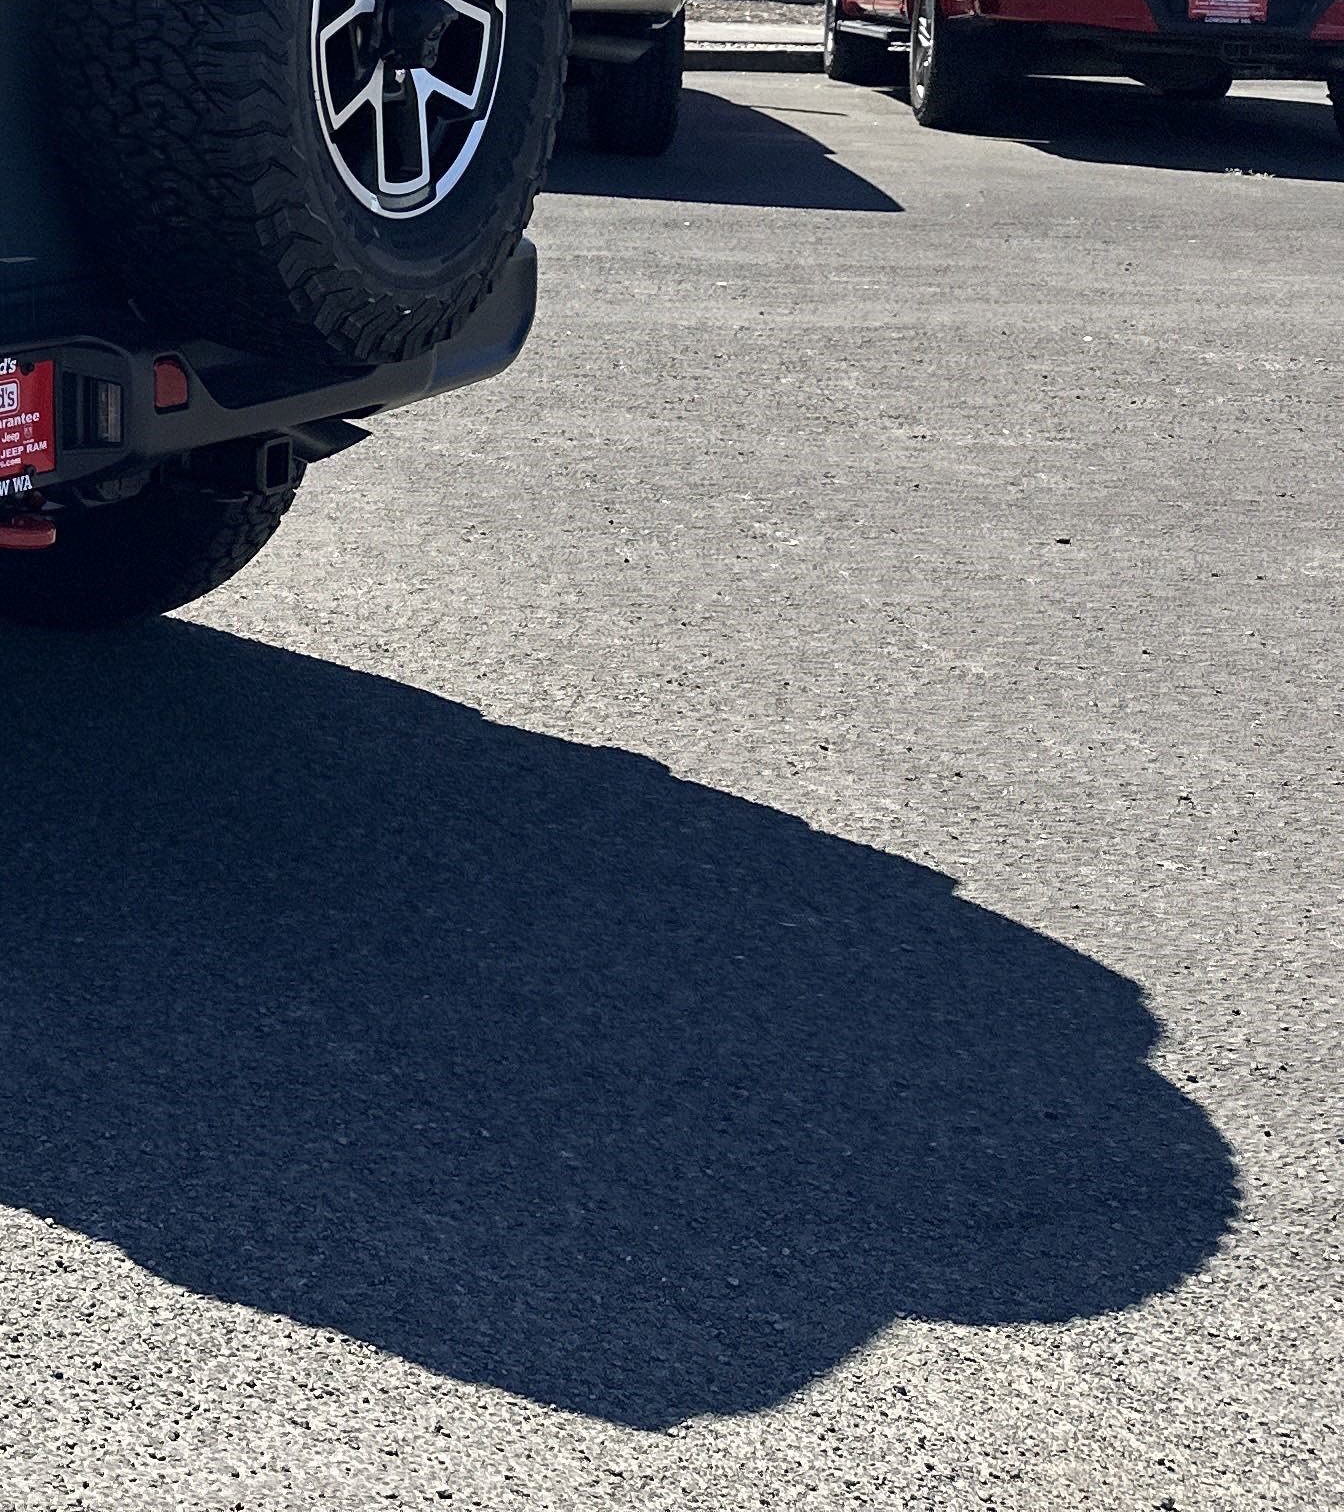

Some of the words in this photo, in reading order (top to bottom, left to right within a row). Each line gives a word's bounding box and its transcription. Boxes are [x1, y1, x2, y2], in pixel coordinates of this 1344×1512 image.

[2, 432, 20, 444] Jeep
[0, 446, 24, 459] JEEP
[26, 440, 48, 454] RAM
[13, 474, 32, 492] WA
